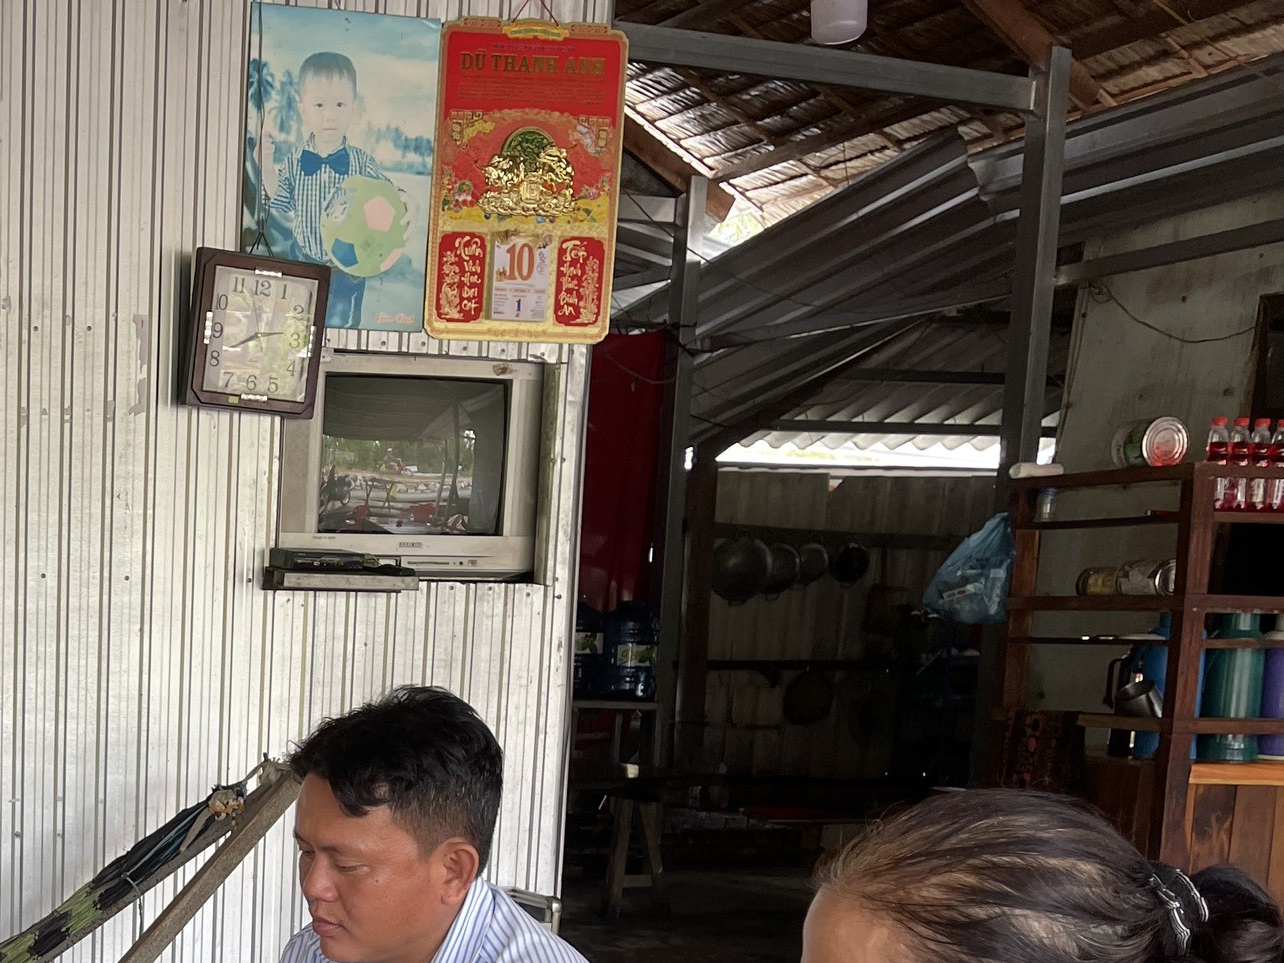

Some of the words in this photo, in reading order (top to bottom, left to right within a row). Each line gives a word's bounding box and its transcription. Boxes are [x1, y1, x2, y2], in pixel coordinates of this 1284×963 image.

[506, 243, 535, 281] 10
[232, 277, 246, 294] 11
[254, 280, 272, 297] 12
[282, 284, 288, 300] 1
[216, 294, 228, 310] 10
[516, 298, 522, 312] 1
[293, 305, 304, 321] 2
[212, 322, 224, 338] 9
[289, 333, 300, 349] 3
[209, 350, 220, 366] 8
[286, 361, 297, 377] 4
[223, 372, 234, 388] 7
[246, 375, 257, 390] 6
[267, 377, 278, 393] 5
